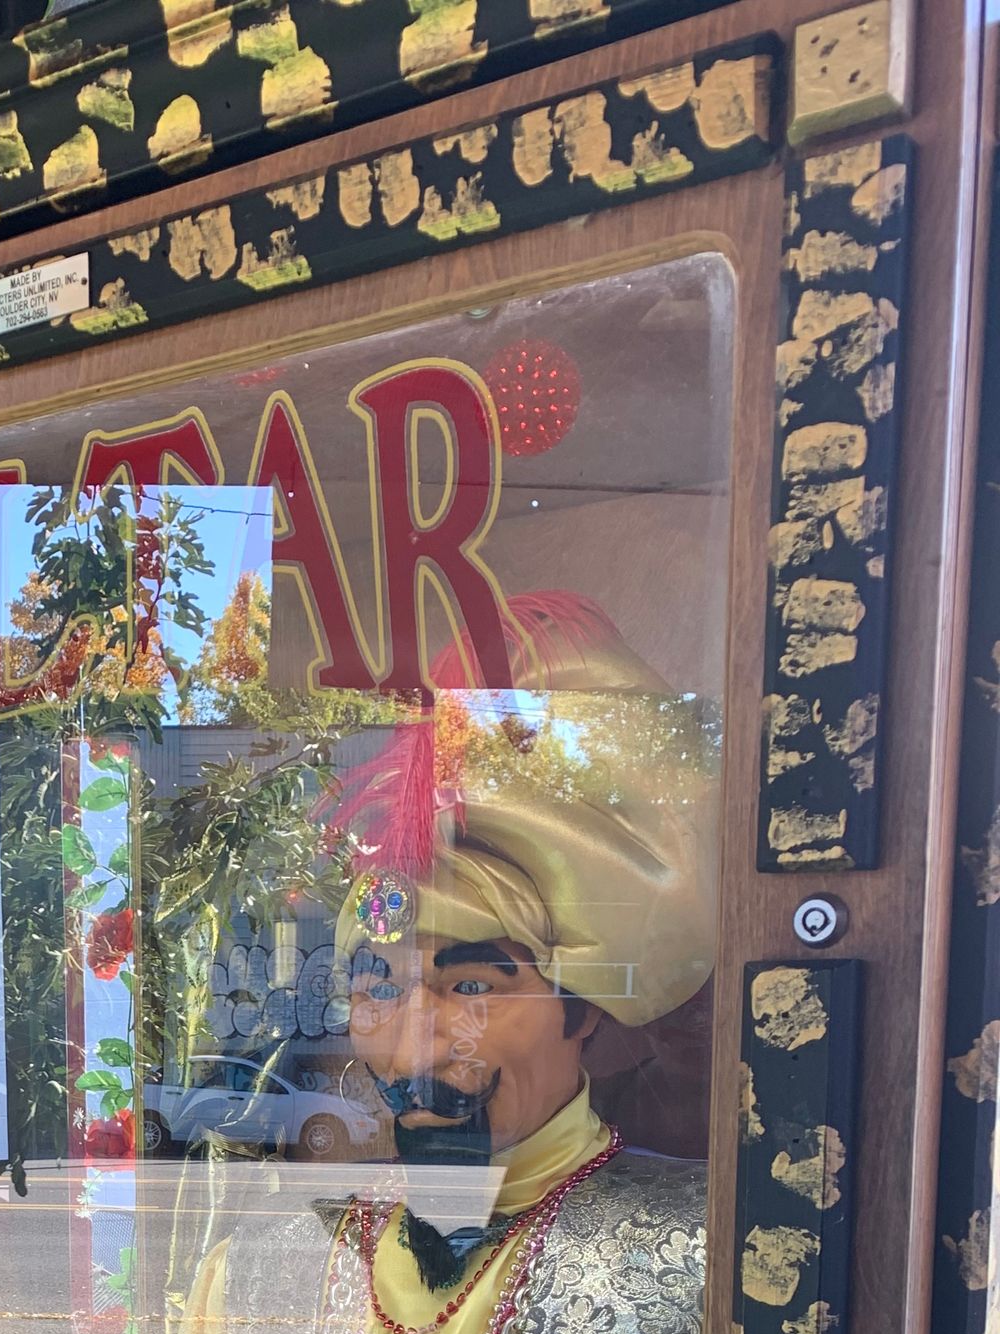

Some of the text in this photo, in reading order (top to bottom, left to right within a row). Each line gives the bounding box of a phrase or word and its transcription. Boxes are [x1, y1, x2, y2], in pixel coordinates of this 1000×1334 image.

[10, 270, 42, 289] MADE BY
[23, 278, 63, 297] UNLIMITED,
[65, 272, 80, 286] INC.
[49, 290, 59, 302] NV
